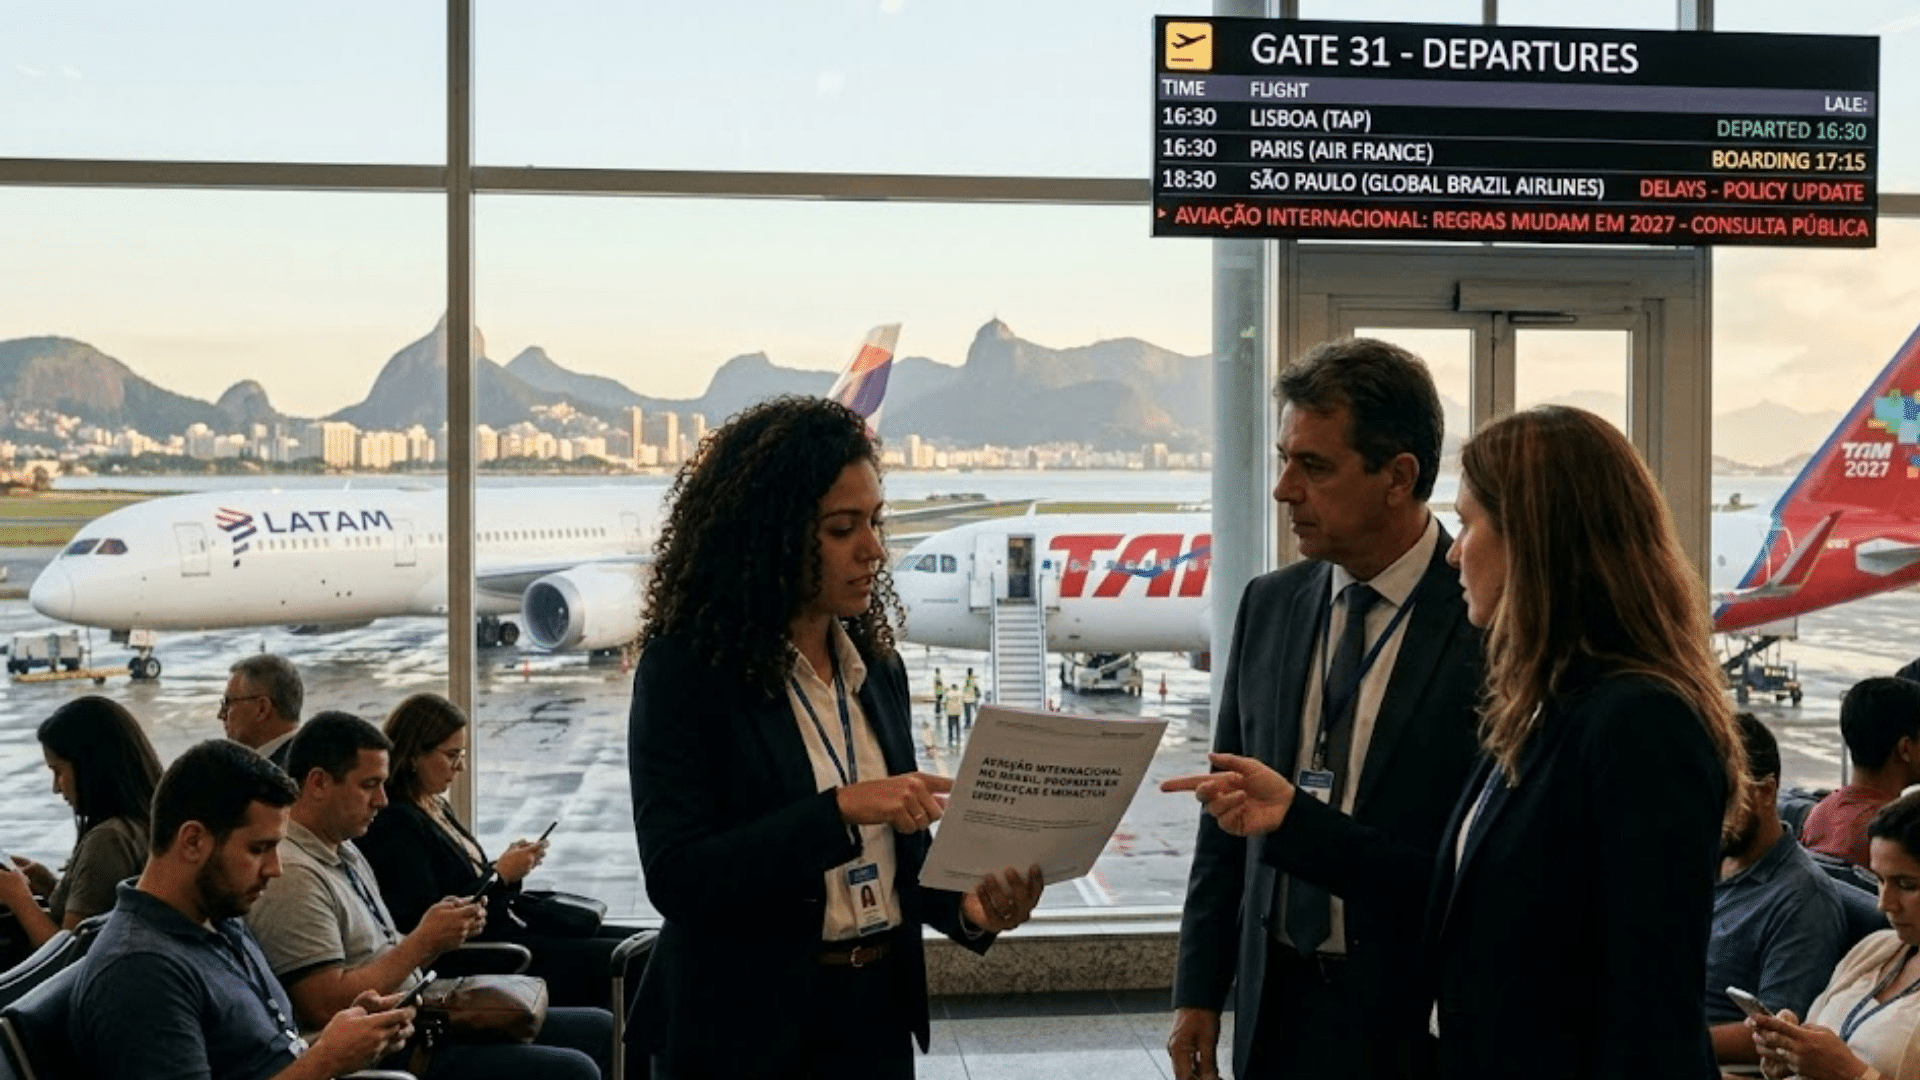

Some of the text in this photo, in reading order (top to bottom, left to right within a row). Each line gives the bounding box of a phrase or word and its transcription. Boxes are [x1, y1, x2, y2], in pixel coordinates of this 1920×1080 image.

[1252, 32, 1338, 65] GATE
[1350, 36, 1390, 66] 31
[1424, 38, 1638, 73] DEPARTURES
[1162, 79, 1205, 96] TIME
[1251, 82, 1309, 97] FLIGHT
[1164, 107, 1216, 125] 16:30
[1251, 109, 1371, 132] LISBOA (TAP)
[1718, 120, 1866, 140] DEPARTED 16:30
[1164, 138, 1216, 157] 16:30
[1251, 140, 1433, 165] PARIS (AIR FRANCE)
[1713, 151, 1865, 170] BOARDING 17:15
[1164, 170, 1216, 189] 18:30
[1251, 169, 1604, 199] SÃO PAULO (GLOBAL BRAZIL AIRLINES)
[1641, 180, 1706, 198] DELAYS
[1724, 181, 1787, 199] POLICY
[1793, 183, 1863, 201] UPDATE
[1176, 204, 1261, 228] AVIAÇÃO
[1268, 209, 1429, 227] INTERNACIONAL:
[1434, 212, 1505, 229] REGRAS
[1512, 214, 1588, 230] MUDAM
[1596, 215, 1623, 231] EM
[1631, 216, 1674, 232] 2027
[1692, 217, 1786, 234] CONSULTA
[1793, 218, 1868, 236] PÚBLICA
[1841, 442, 1894, 459] TAM
[1845, 460, 1891, 478] 2027
[262, 510, 394, 533] LATAM
